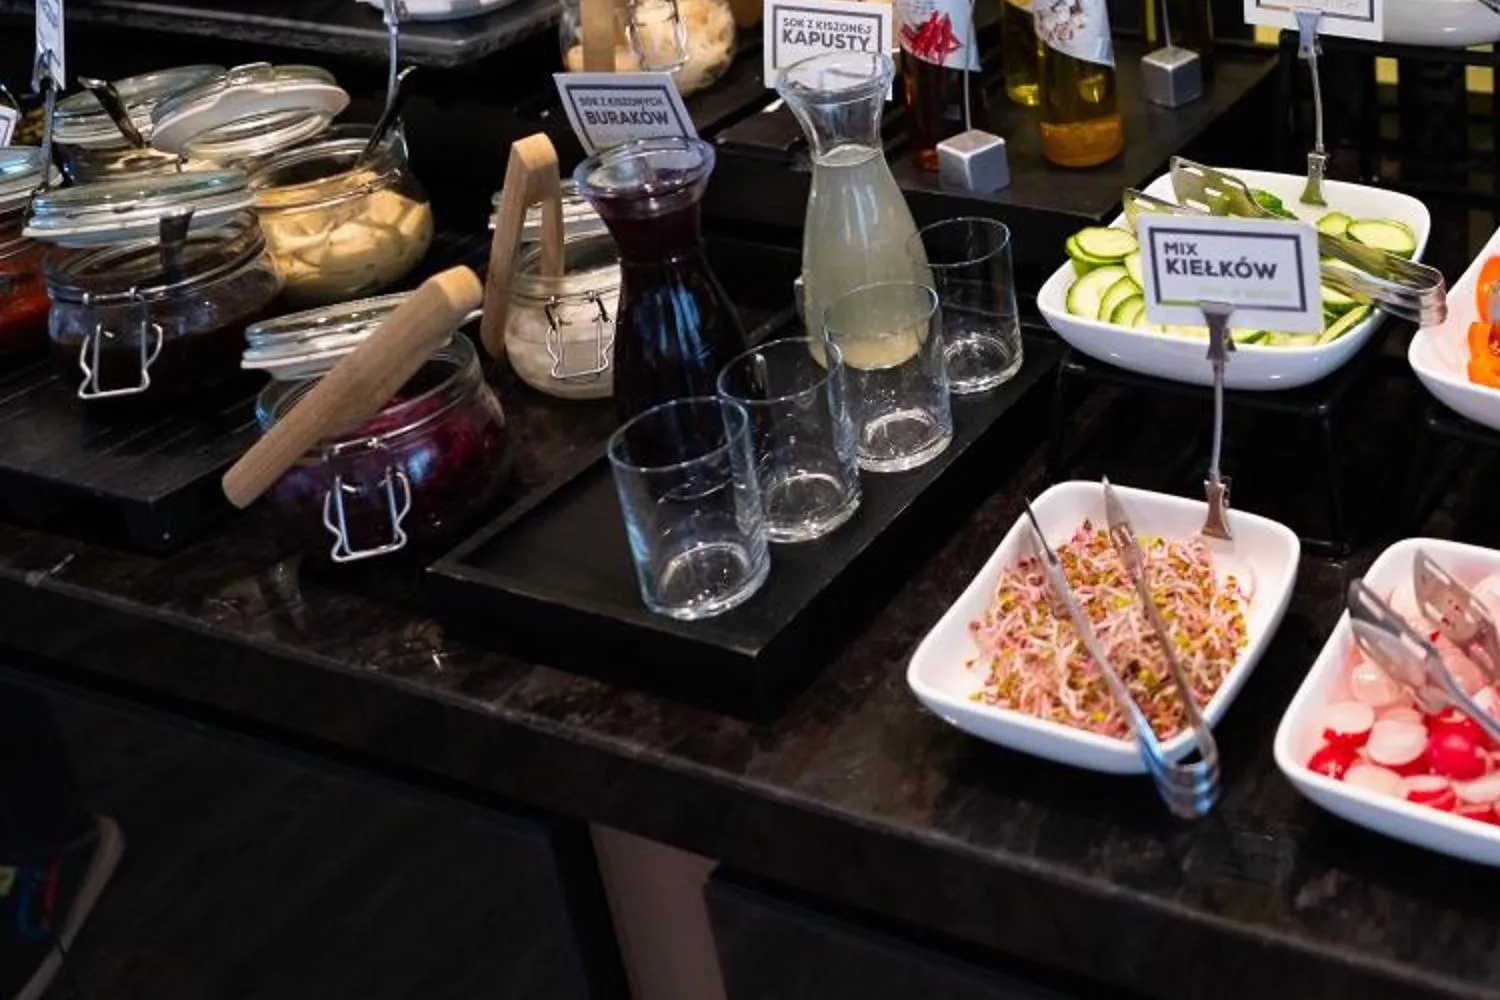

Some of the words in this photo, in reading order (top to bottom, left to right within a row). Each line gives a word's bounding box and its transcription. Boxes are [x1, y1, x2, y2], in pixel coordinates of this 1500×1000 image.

[783, 17, 805, 28] SOK
[807, 20, 814, 29] Z
[815, 20, 873, 34] KISZONEJ
[782, 29, 871, 50] KAPUSTY
[585, 106, 668, 125] BURAKÓW
[1163, 241, 1199, 256] MIX
[1165, 256, 1277, 280] KIEŁKÓW
